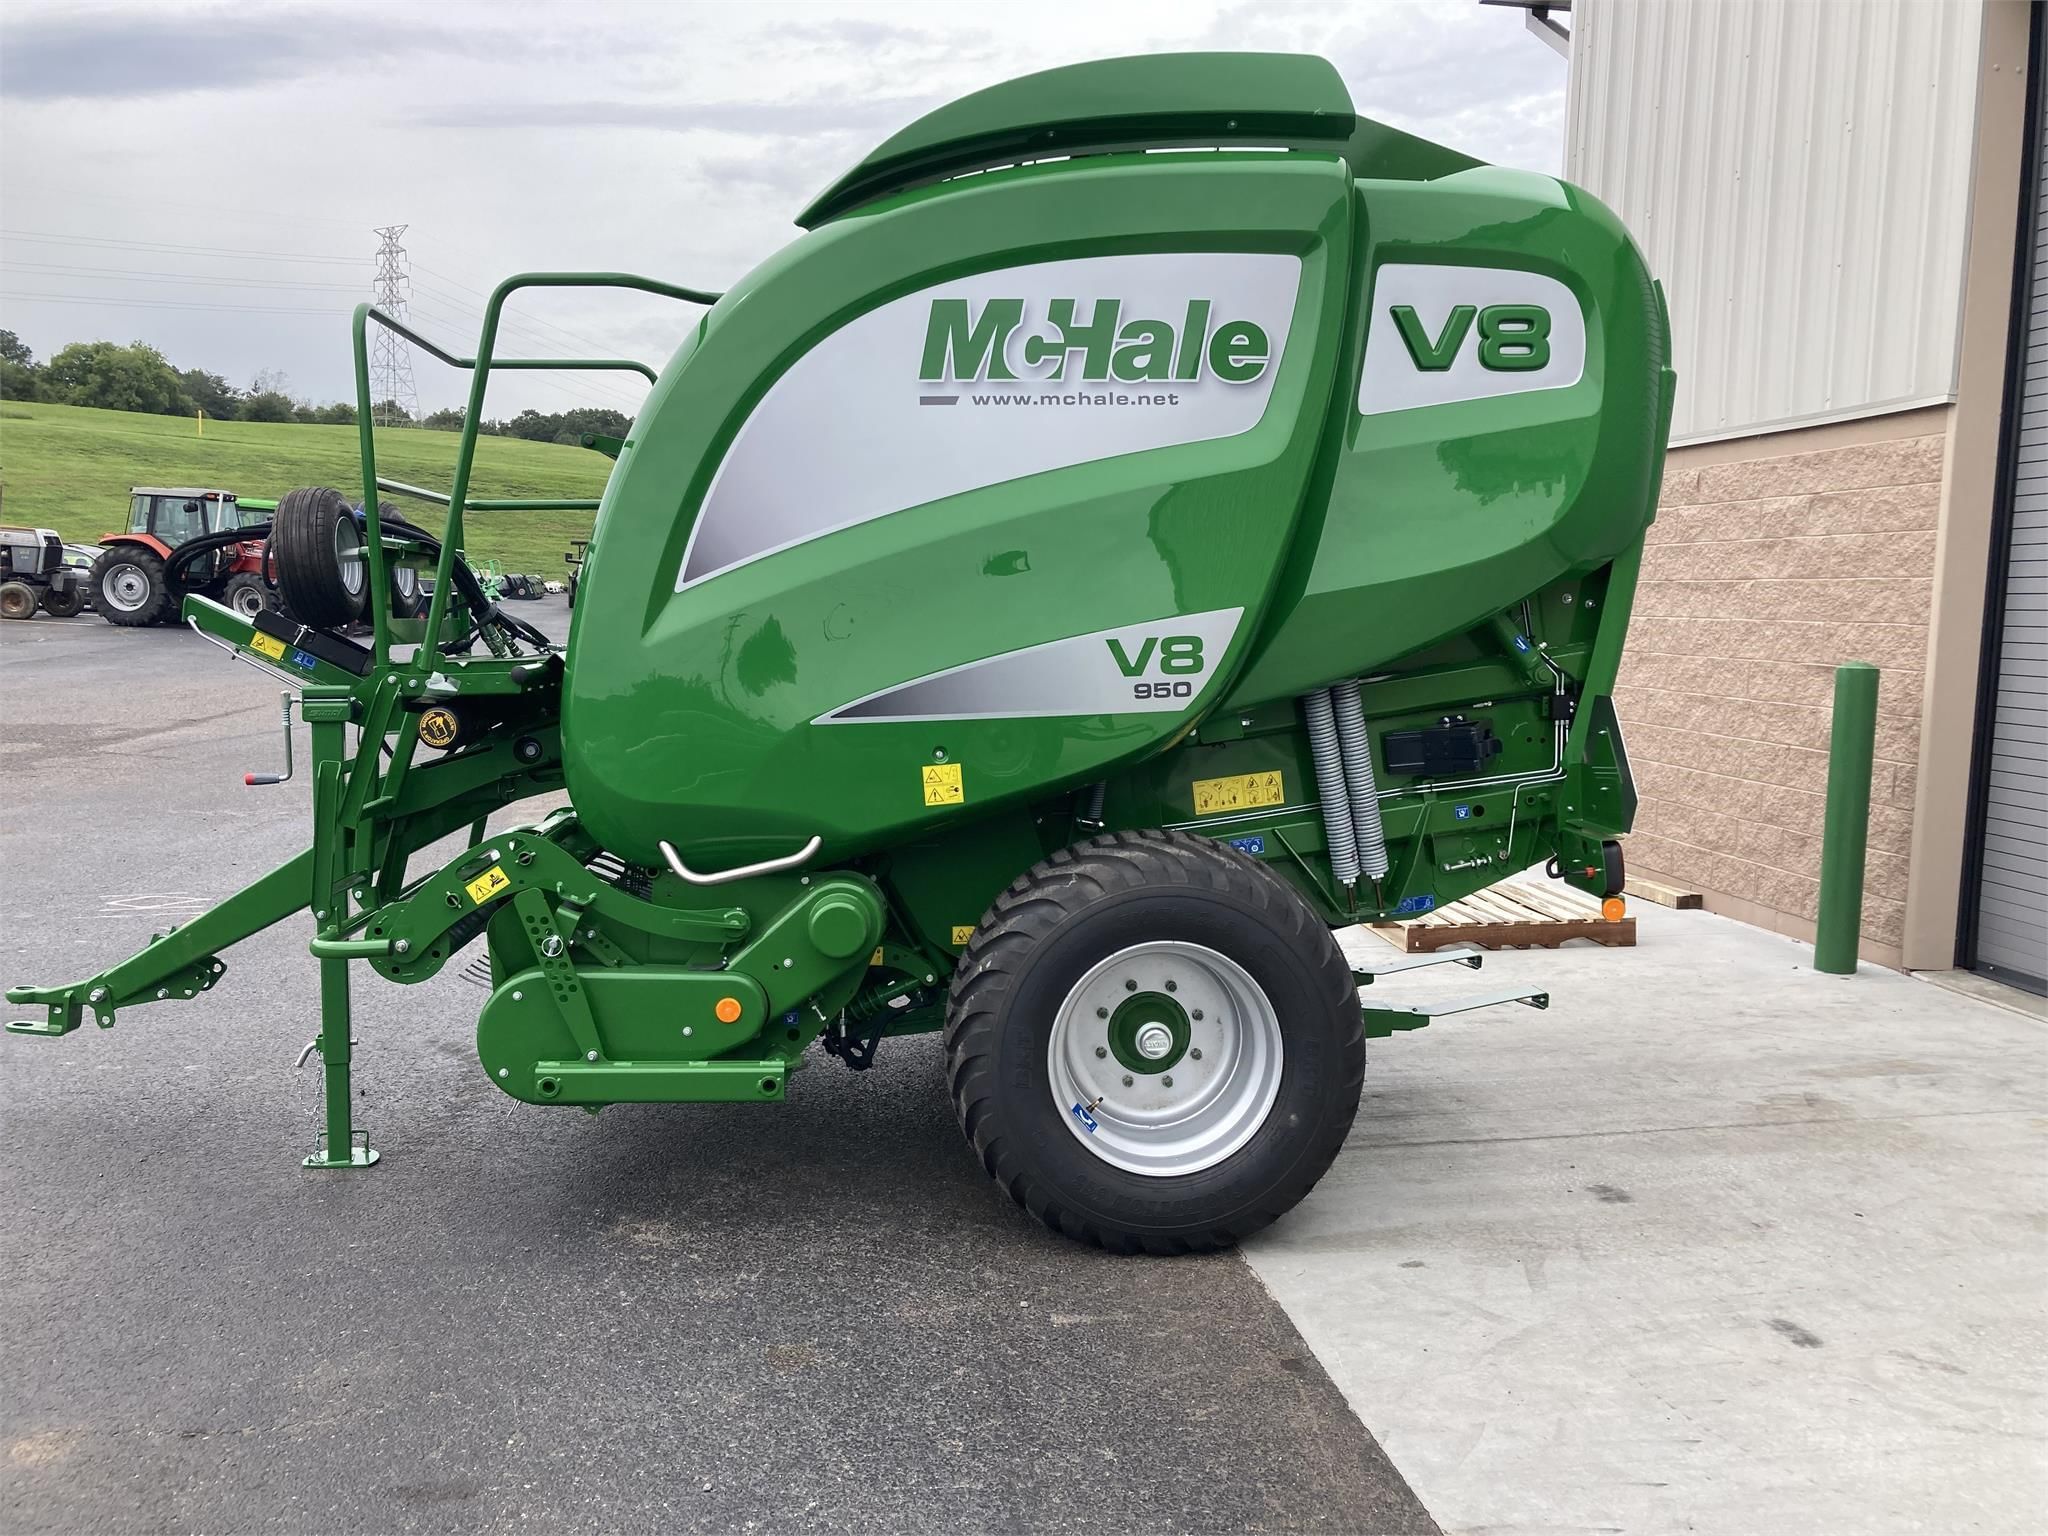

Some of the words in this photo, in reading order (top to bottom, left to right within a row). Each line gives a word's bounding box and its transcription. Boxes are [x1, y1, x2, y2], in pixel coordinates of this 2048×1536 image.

[918, 298, 1270, 382] McHale
[1389, 305, 1552, 372] V8
[972, 392, 1180, 406] www.mchale.net
[1105, 635, 1204, 677] V8
[1134, 682, 1192, 700] 950
